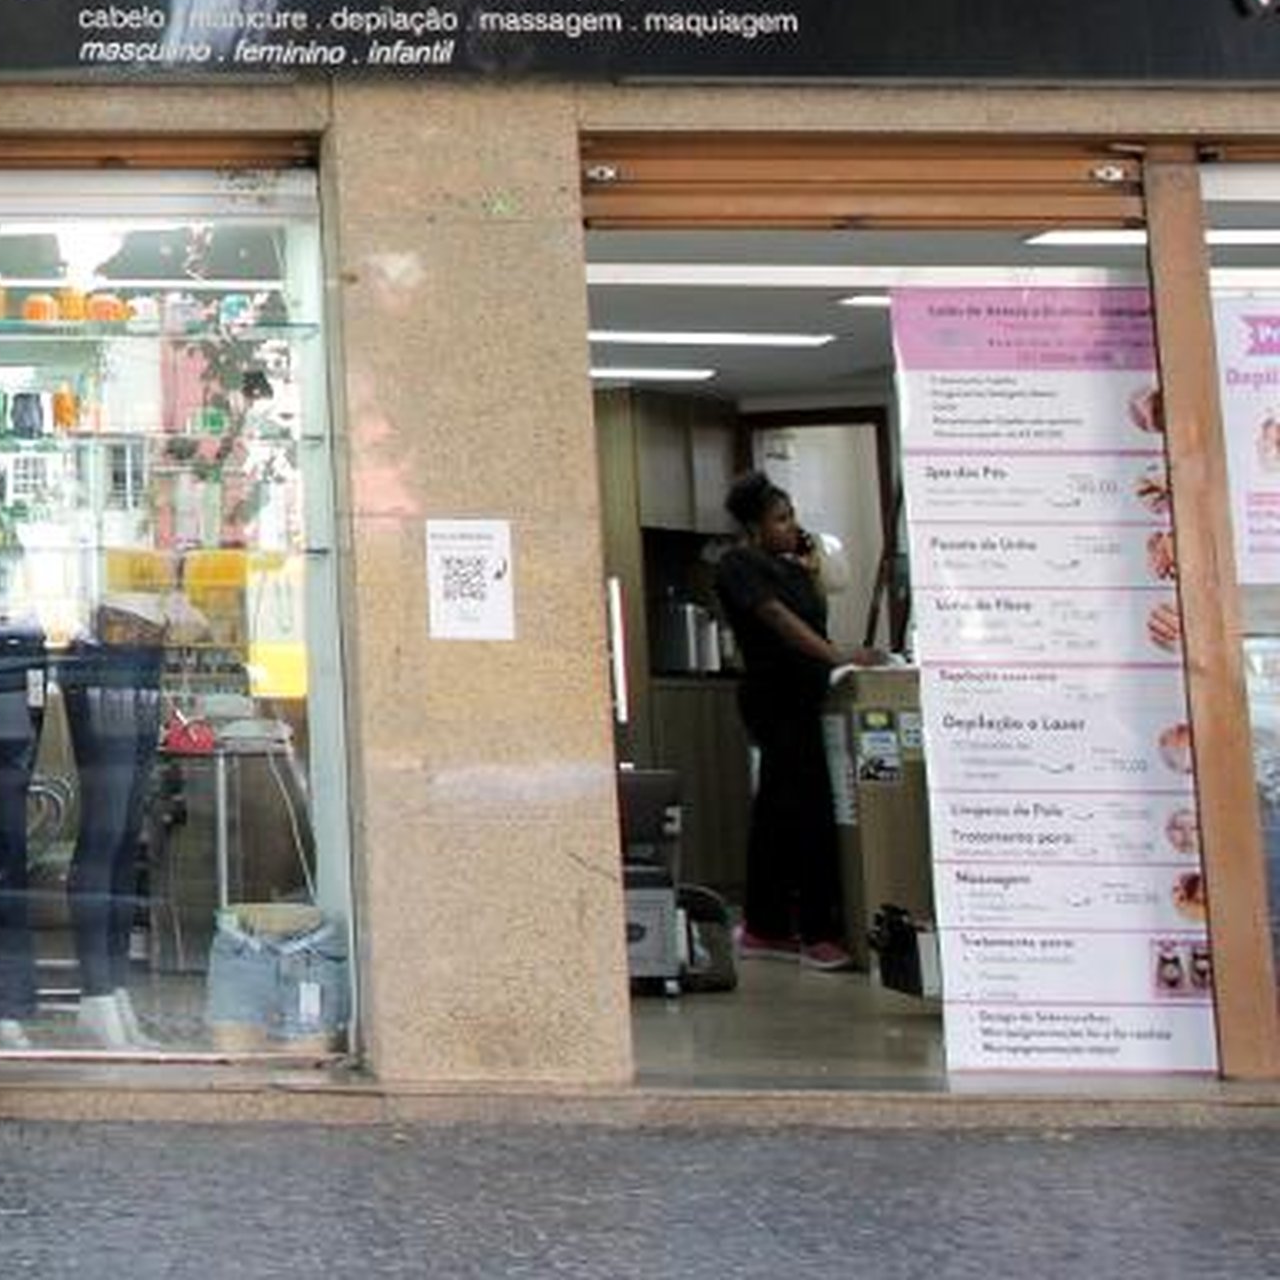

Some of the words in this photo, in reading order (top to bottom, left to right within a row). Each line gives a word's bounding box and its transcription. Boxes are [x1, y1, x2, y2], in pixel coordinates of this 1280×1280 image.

[77, 4, 166, 31] cabelo
[188, 6, 309, 32] manicure
[330, 6, 459, 37] depilação
[479, 8, 622, 36] massagem
[644, 8, 799, 36] maquiagem
[78, 38, 212, 64] masculino
[233, 38, 346, 66] feminino
[366, 38, 455, 66] infantil
